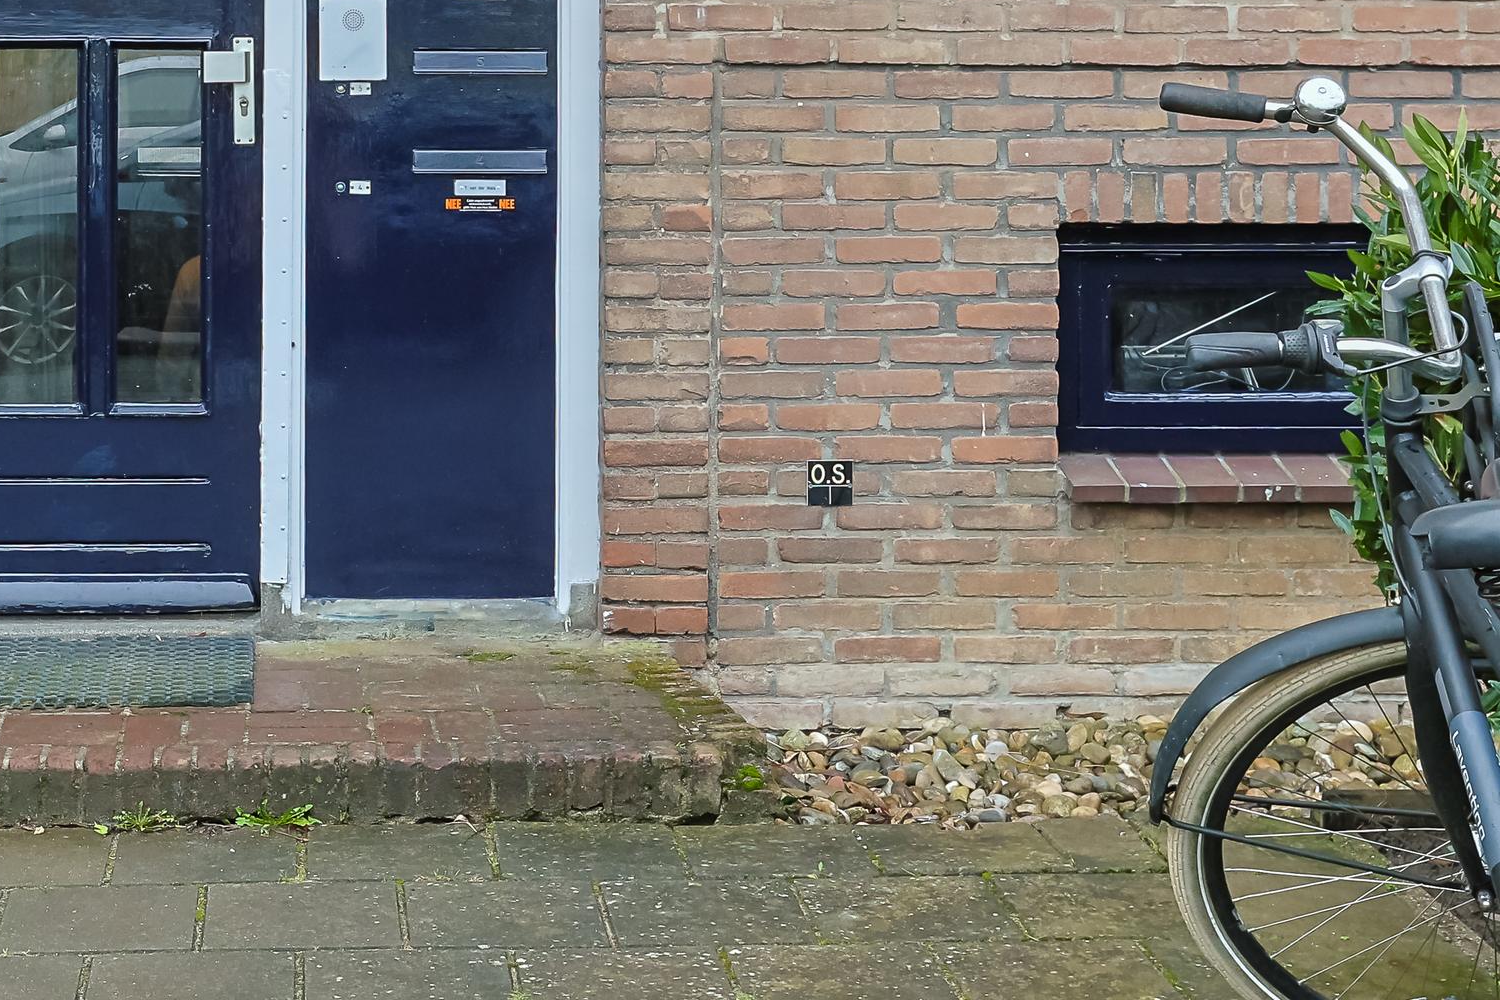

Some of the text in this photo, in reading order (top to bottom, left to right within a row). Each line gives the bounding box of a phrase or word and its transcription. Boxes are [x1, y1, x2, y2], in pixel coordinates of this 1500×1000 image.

[476, 55, 485, 67] 5
[445, 198, 462, 210] NEE
[498, 198, 515, 210] NEE
[811, 463, 851, 485] O.S.
